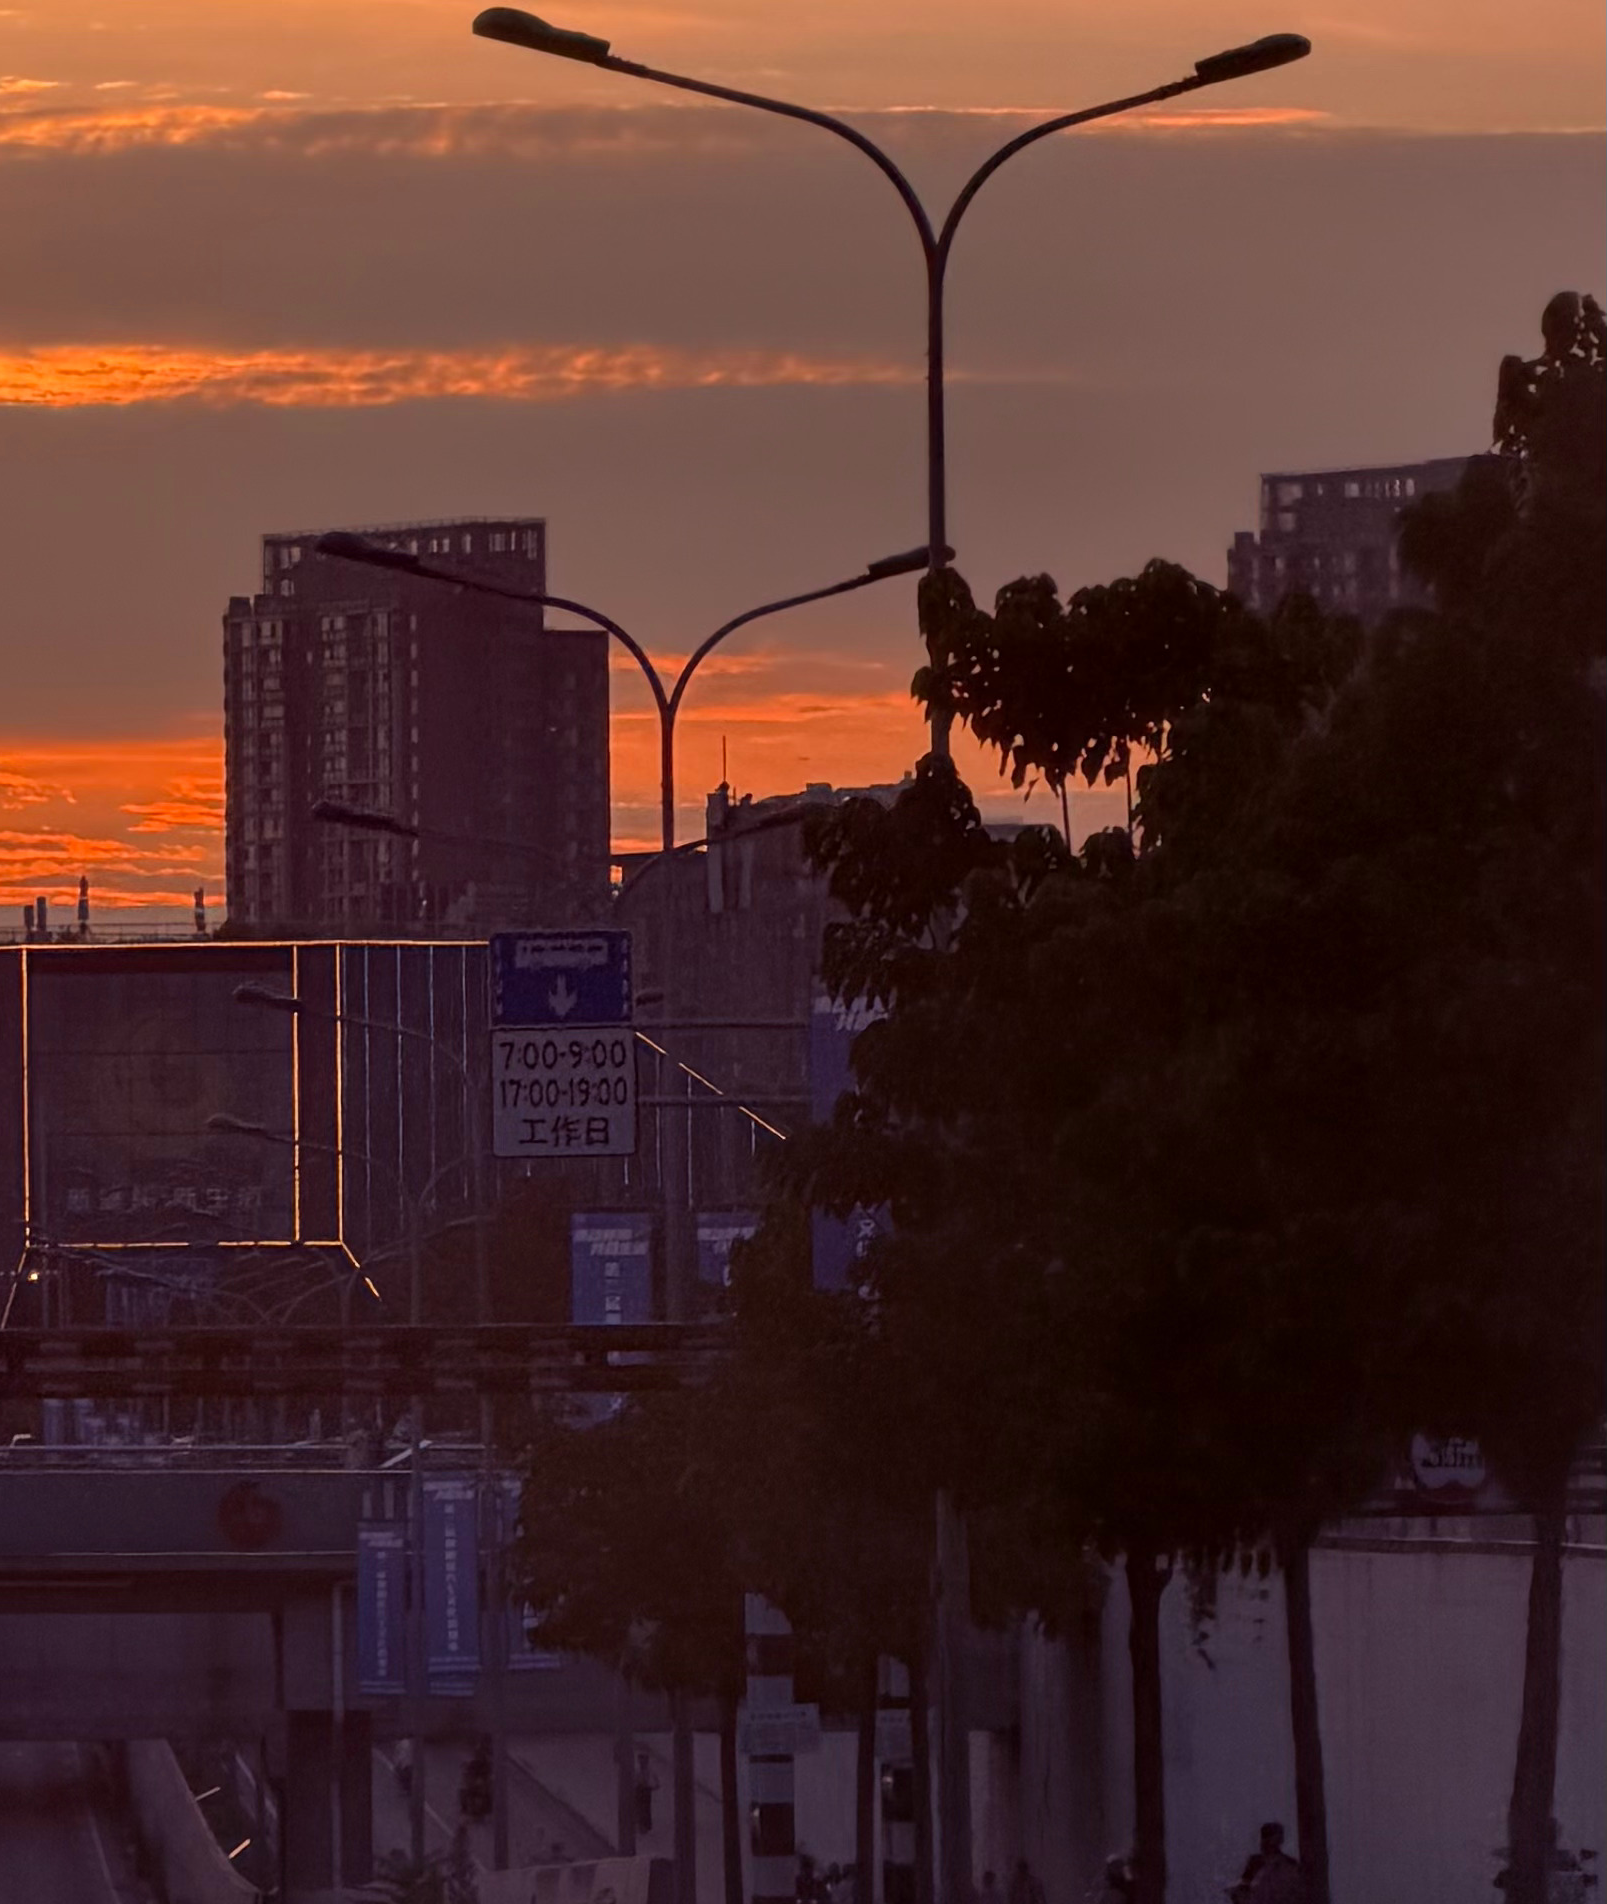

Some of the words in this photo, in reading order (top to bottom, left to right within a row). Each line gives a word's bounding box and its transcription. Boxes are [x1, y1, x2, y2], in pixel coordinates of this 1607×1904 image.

[499, 1039, 627, 1070] 7:00-9:00
[500, 1076, 628, 1108] 17:00-19:00
[519, 1116, 610, 1148] 工作日
